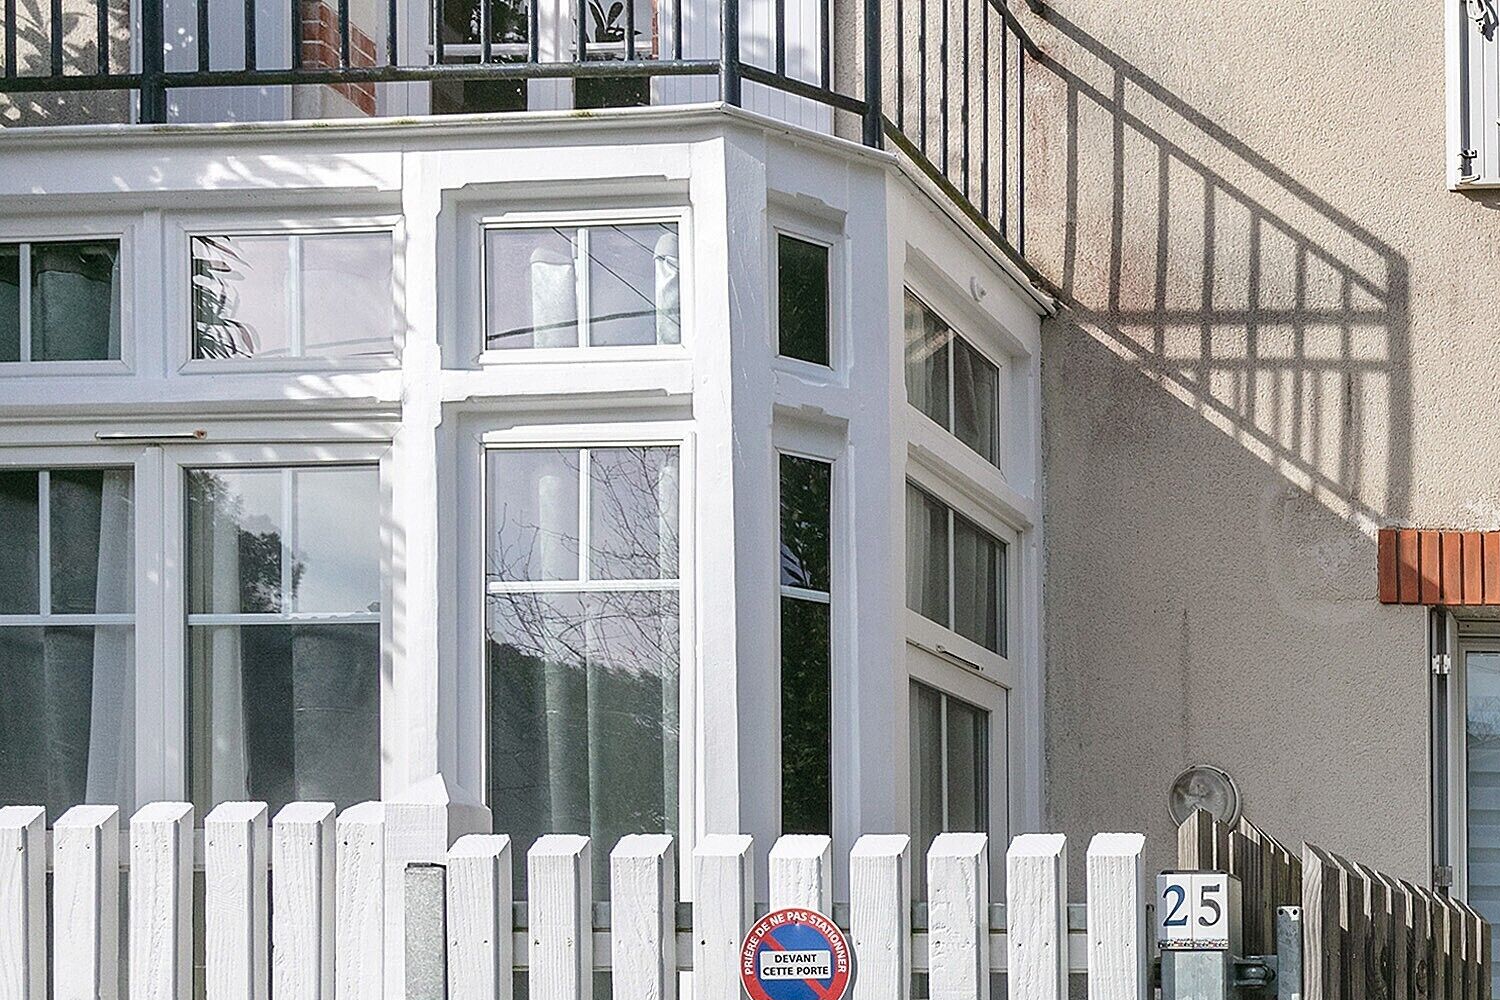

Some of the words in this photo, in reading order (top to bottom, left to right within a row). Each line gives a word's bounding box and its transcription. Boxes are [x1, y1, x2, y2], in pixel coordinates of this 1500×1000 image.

[1163, 884, 1221, 927] 25
[755, 922, 770, 938] DE
[769, 914, 785, 927] NE
[786, 911, 808, 922] PAS
[809, 914, 848, 974] STATIONNER
[762, 966, 793, 976] CETTE
[796, 965, 829, 975] PORTE
[774, 954, 817, 963] DEVANT
